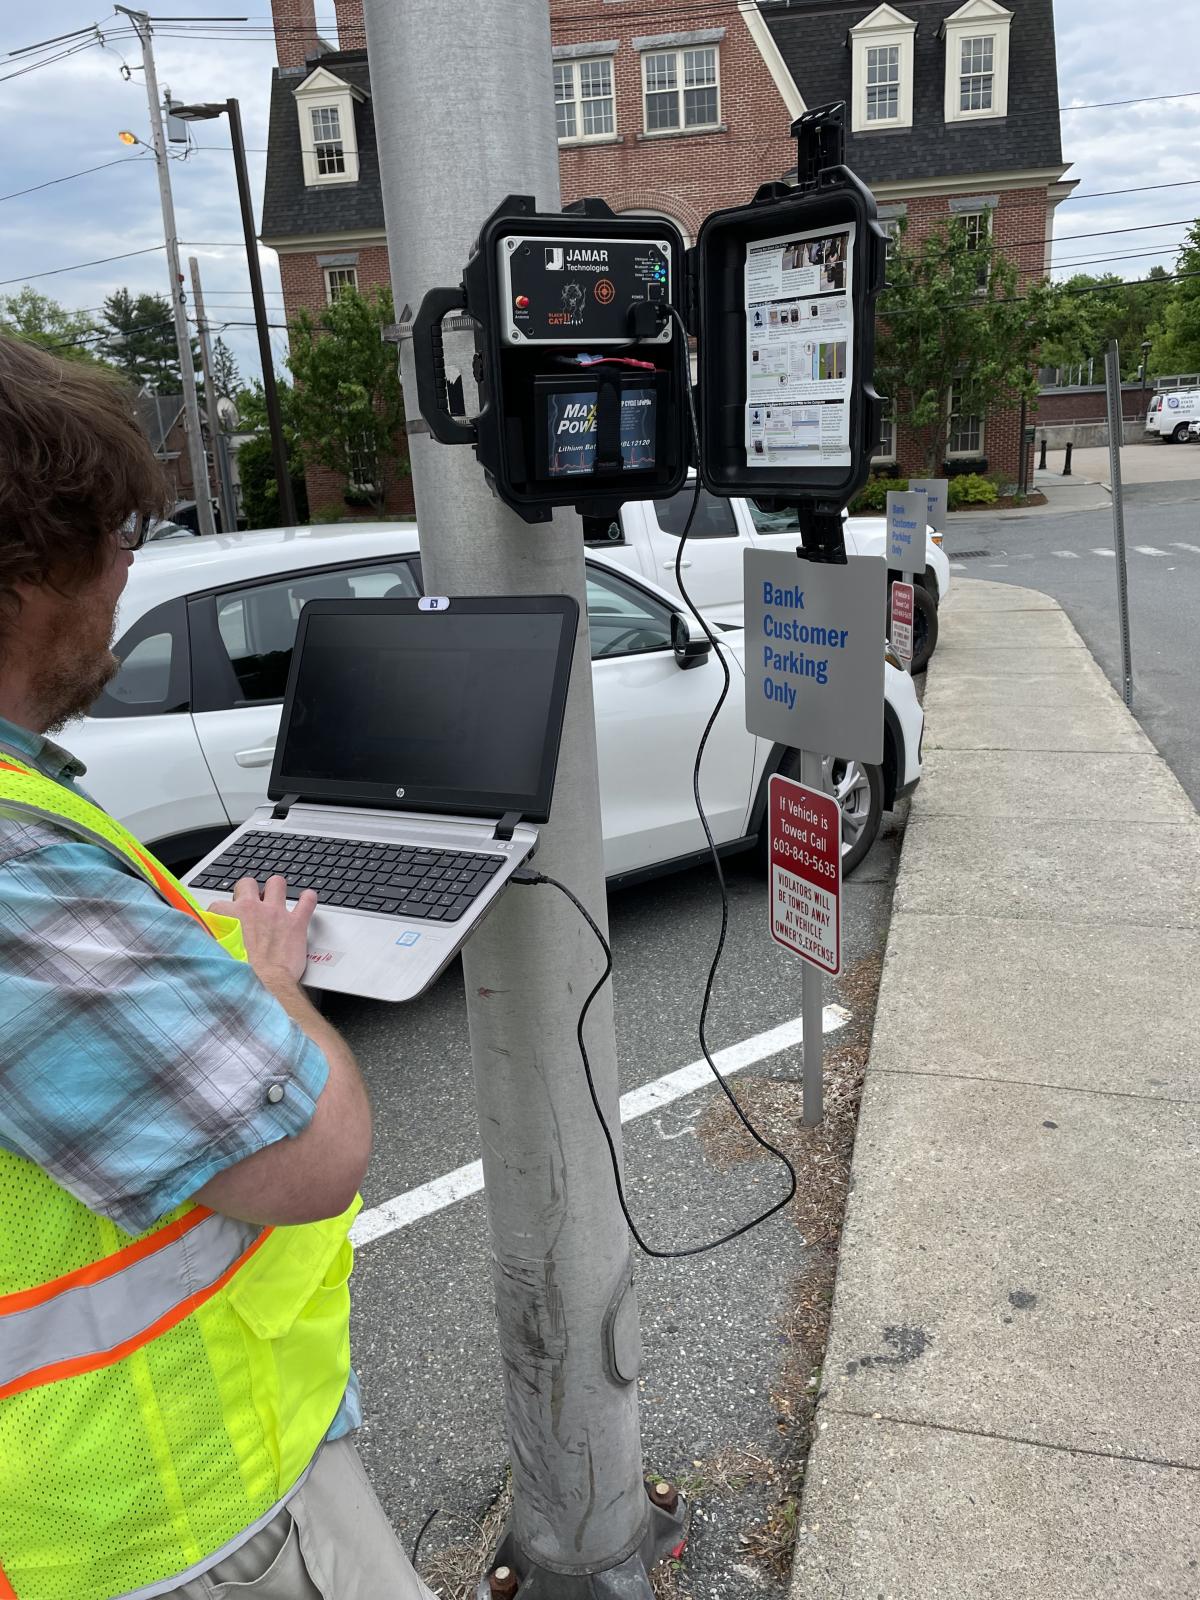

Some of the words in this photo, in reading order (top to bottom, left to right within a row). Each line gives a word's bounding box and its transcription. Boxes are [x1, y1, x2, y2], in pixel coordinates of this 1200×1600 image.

[566, 249, 609, 262] JAMAR
[566, 263, 609, 273] Technologies
[563, 403, 598, 419] MAX
[557, 420, 598, 435] POWE
[558, 444, 584, 453] Lithium
[892, 504, 905, 514] Bank
[892, 518, 918, 529] Customer
[892, 531, 912, 545] Parking
[892, 545, 903, 556] Only
[763, 581, 805, 609] Bank
[763, 614, 849, 648] Customer
[763, 646, 829, 685] Parking
[763, 677, 797, 710] Only
[780, 796, 786, 811] If
[788, 799, 818, 825] Vehicle
[821, 814, 828, 830] is
[781, 818, 807, 843] Towed
[810, 832, 827, 852] Call
[773, 837, 836, 879] 603-843-5635
[778, 872, 812, 901] VIOLATORS
[814, 892, 831, 911] WILL
[778, 889, 786, 904] BE
[788, 894, 809, 916] TOWED
[811, 907, 830, 927] AWAY
[785, 910, 793, 923] AT
[795, 915, 823, 941] VEHICLE
[775, 920, 803, 946] OWNER'S
[805, 938, 834, 965] EXPENSE
